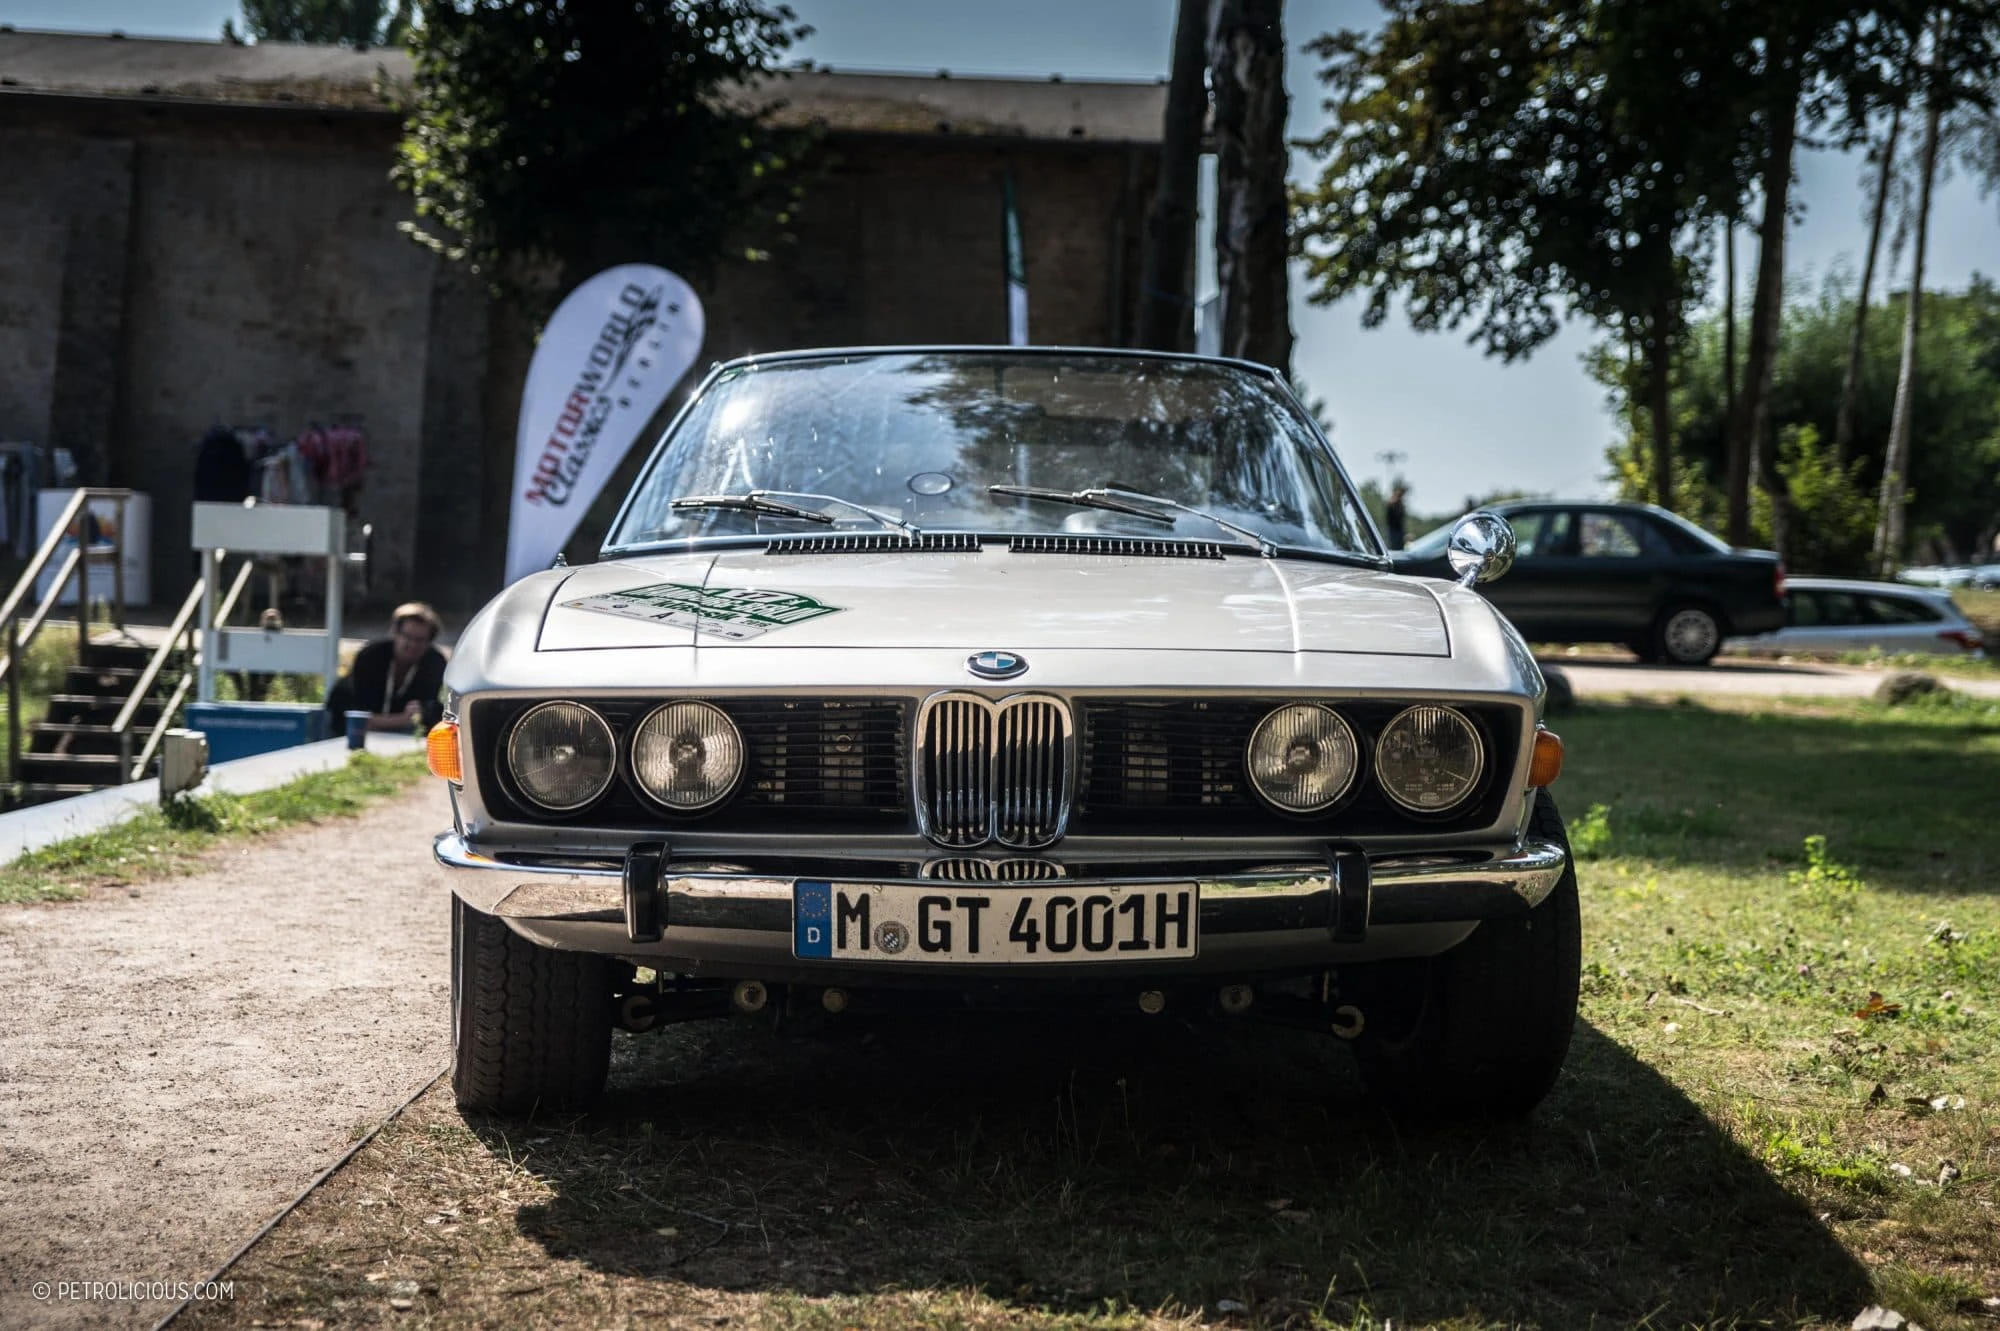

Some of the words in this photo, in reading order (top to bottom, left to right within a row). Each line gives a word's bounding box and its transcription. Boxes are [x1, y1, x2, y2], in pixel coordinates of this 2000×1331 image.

[525, 282, 646, 506] MOTORWORLD
[807, 927, 821, 943] D
[837, 892, 870, 950] M
[918, 895, 990, 953] GT
[1009, 892, 1190, 953] 4001H
